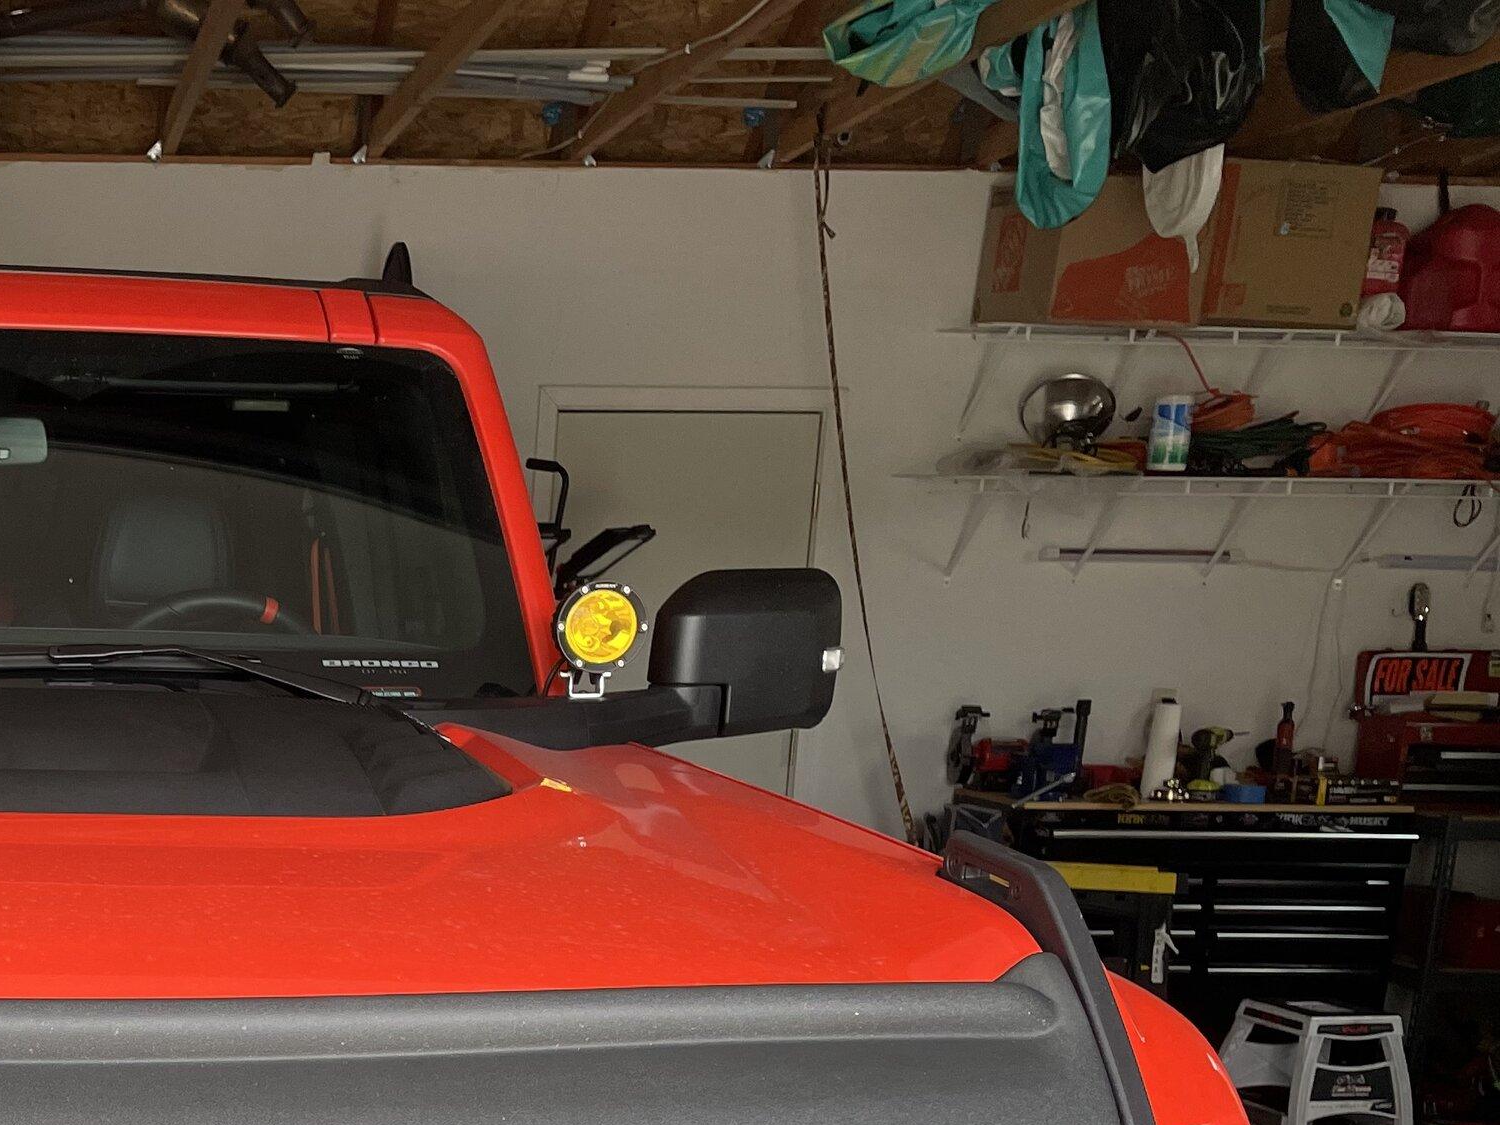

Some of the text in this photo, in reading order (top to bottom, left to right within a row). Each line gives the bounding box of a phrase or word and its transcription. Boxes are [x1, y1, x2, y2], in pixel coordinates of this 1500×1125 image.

[322, 660, 439, 669] BRONCO
[1373, 659, 1461, 693] FOR SALE
